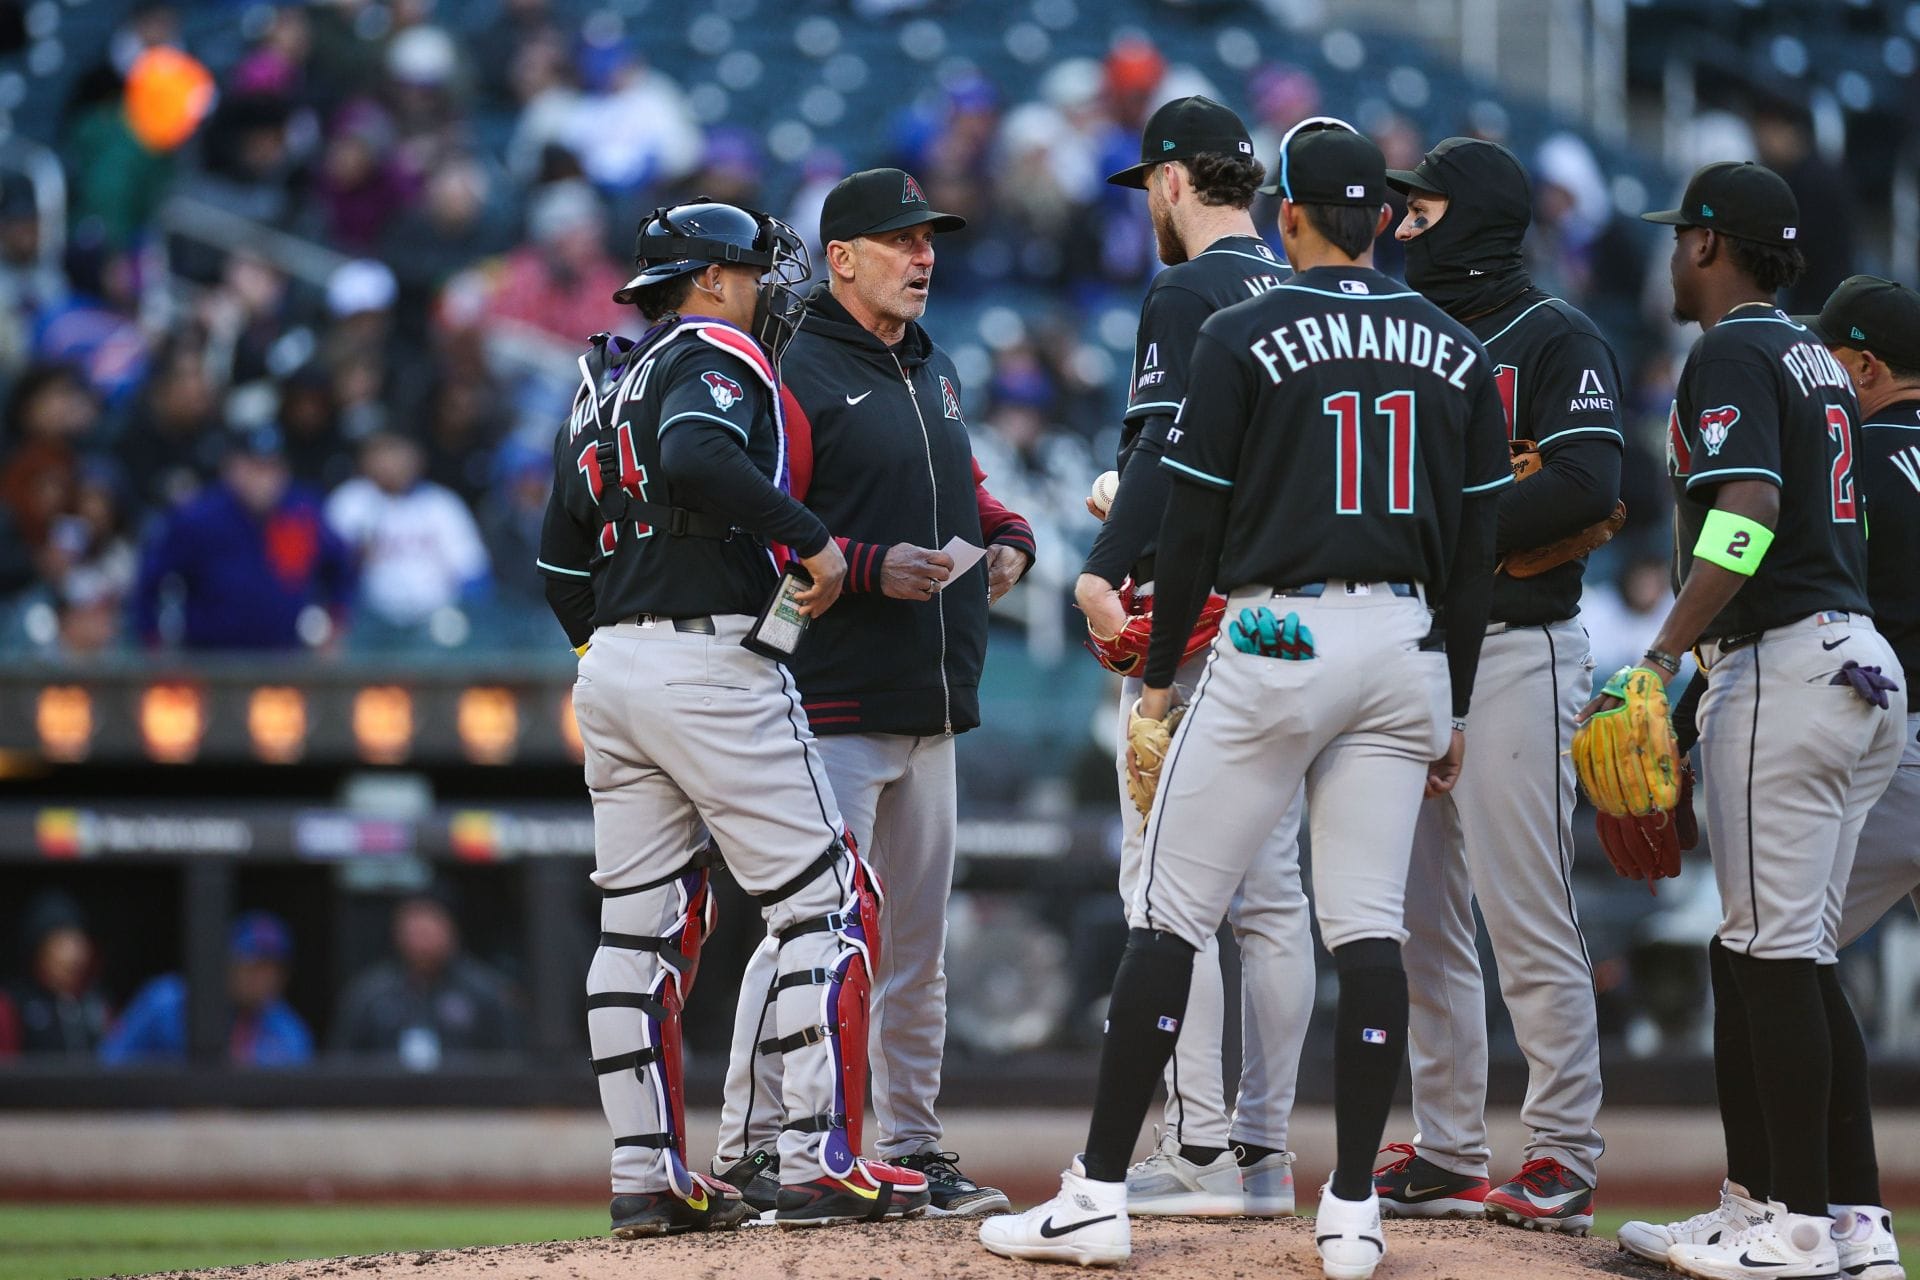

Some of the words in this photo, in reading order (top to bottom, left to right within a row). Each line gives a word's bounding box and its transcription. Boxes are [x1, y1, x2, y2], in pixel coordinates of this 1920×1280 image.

[1250, 313, 1477, 391] FERNANDEZ
[1570, 398, 1613, 412] AVNET
[1323, 390, 1415, 514] 11
[1825, 404, 1856, 523] 2
[1726, 531, 1751, 559] 2
[834, 1151, 845, 1161] 14
